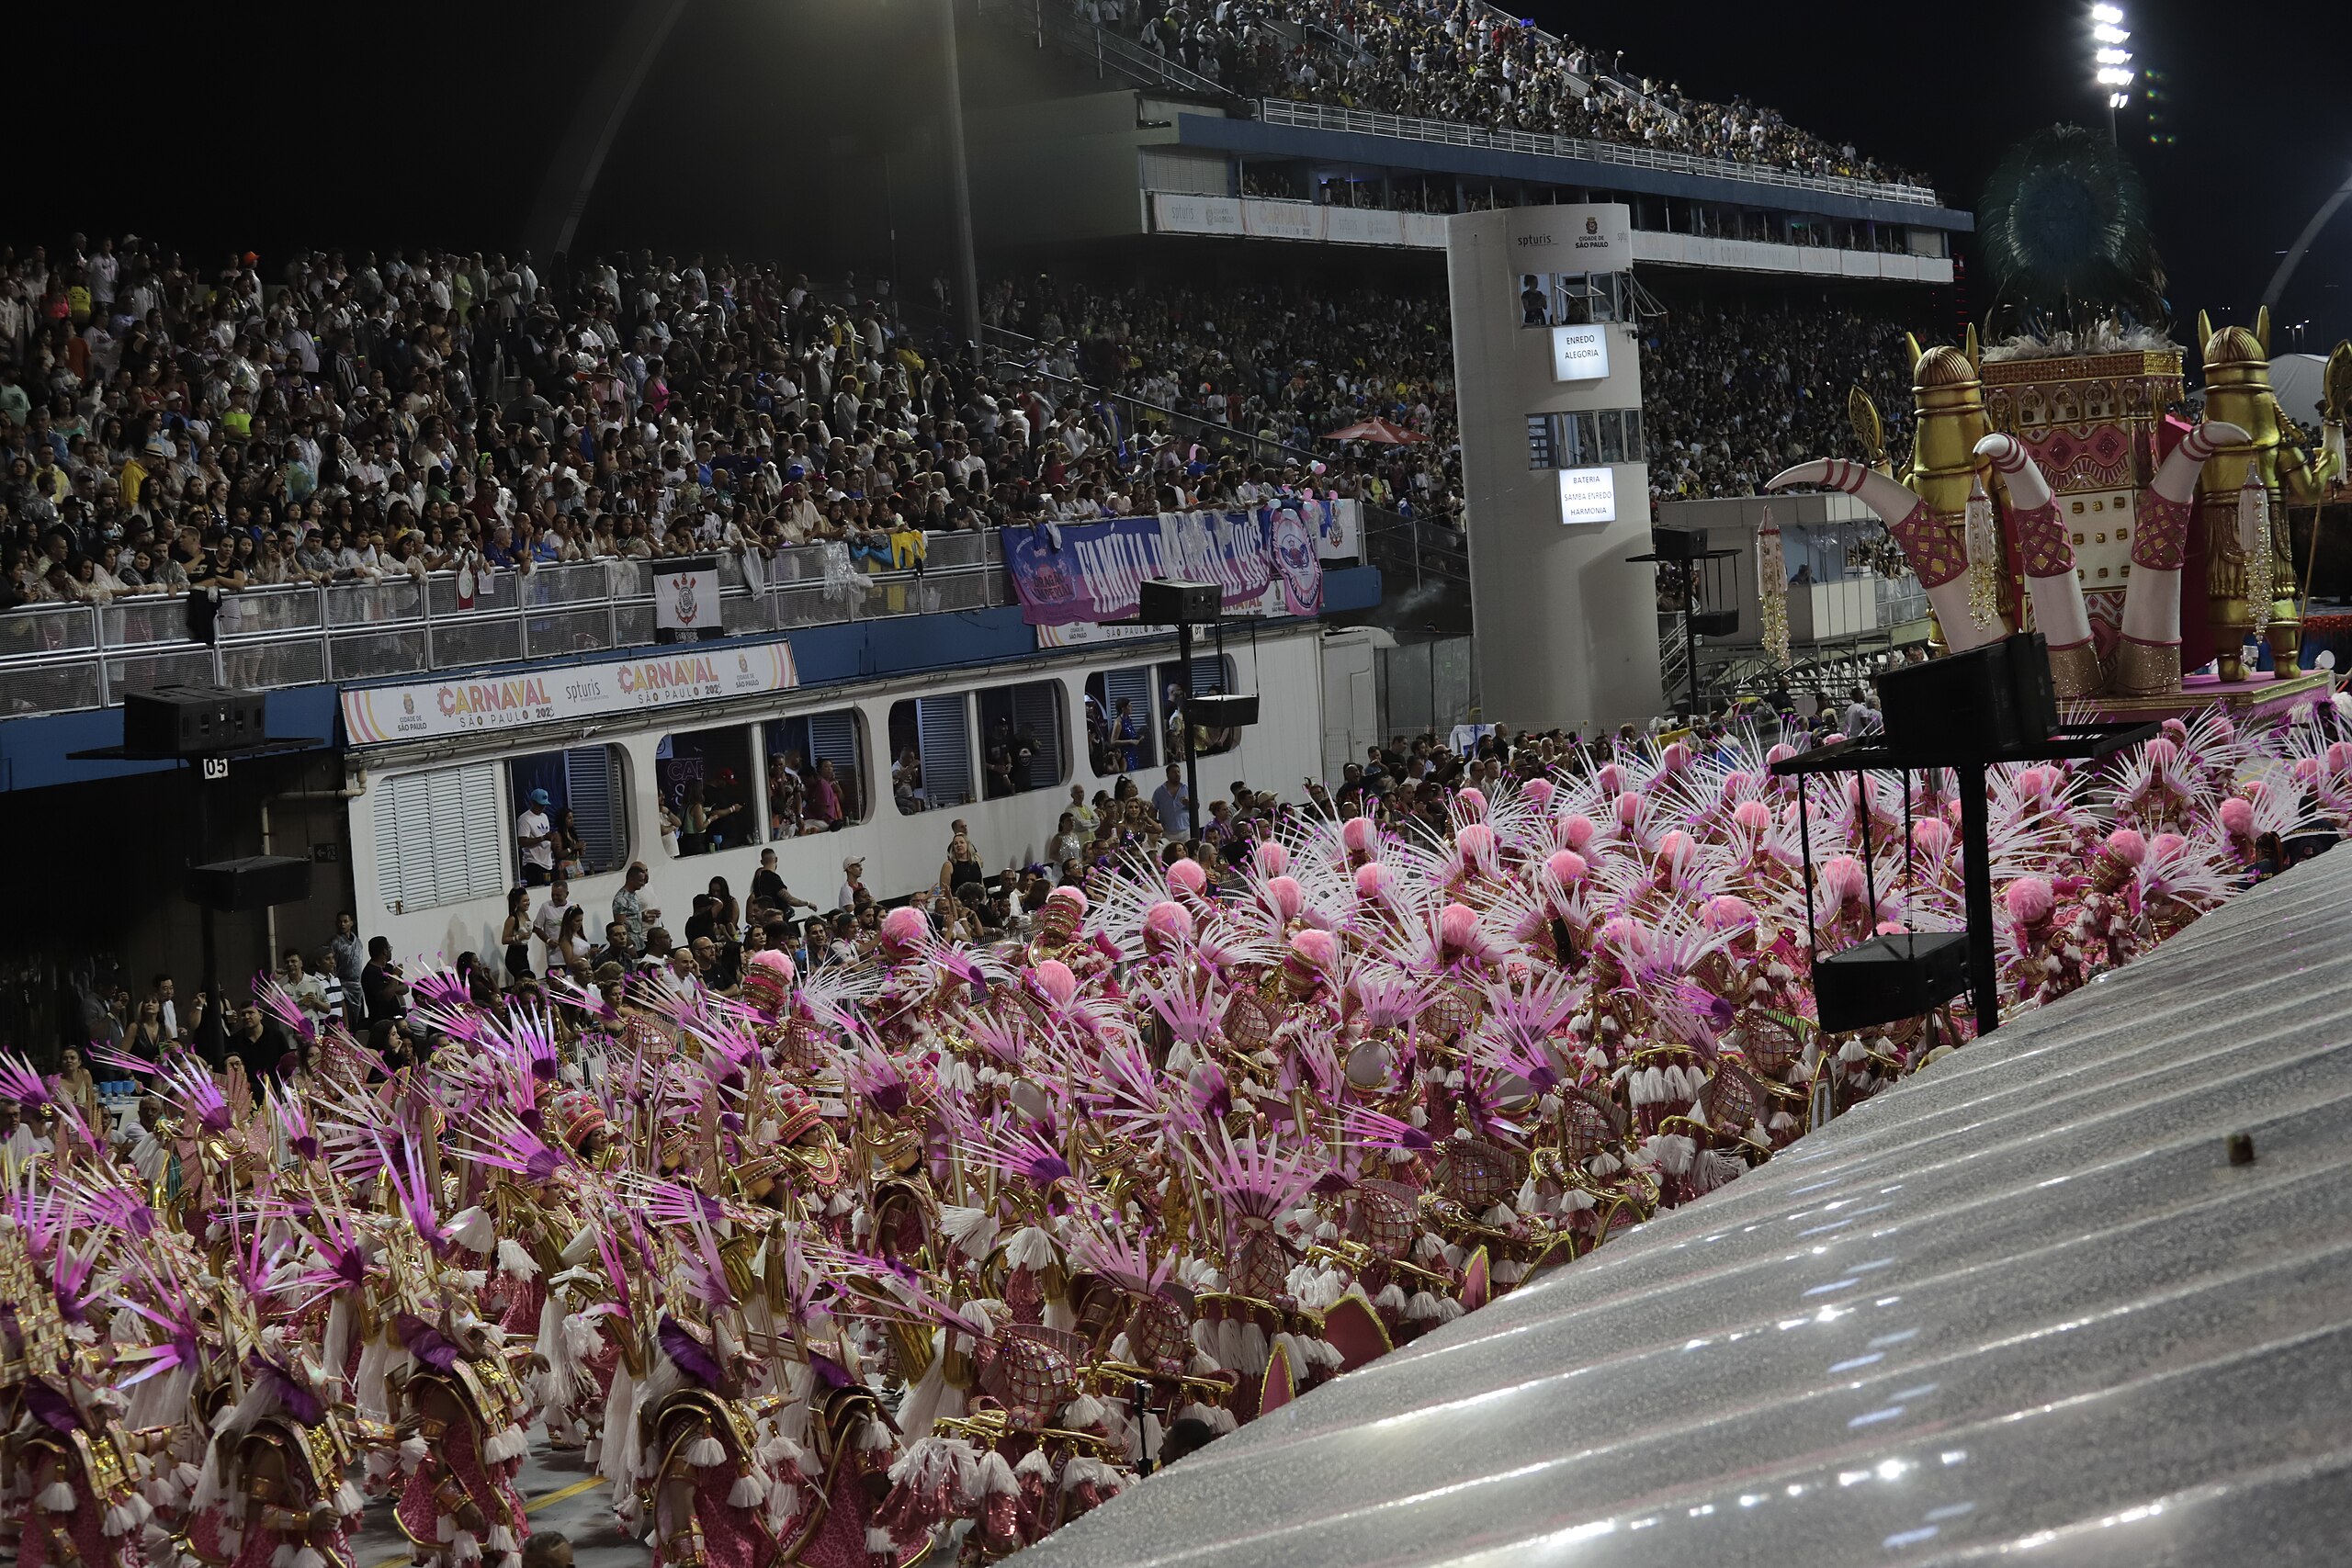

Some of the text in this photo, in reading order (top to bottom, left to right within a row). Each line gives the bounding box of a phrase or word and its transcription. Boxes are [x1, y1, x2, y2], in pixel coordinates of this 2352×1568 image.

[1518, 233, 1552, 247] spturis
[1576, 240, 1589, 249] SÃO
[1566, 334, 1595, 344] ENREDO
[1565, 349, 1599, 359] ALEGORIA
[1573, 476, 1600, 484] BATERIA
[1564, 491, 1611, 502] SAMBA ENREDO
[1570, 507, 1607, 515] HARMONIA
[1106, 626, 1121, 637] SÃO
[1125, 625, 1148, 635] PAULO
[617, 657, 718, 694] CARNAVAL
[745, 679, 760, 687] PAULO
[566, 679, 600, 703] spturis
[639, 692, 659, 705] SÃO
[665, 686, 699, 700] PAULO
[437, 678, 551, 716] CARNAVAL
[460, 714, 483, 728] SÃO
[491, 710, 528, 725] PAULO
[397, 722, 427, 732] SÃO PAULO
[206, 760, 226, 776] 05
